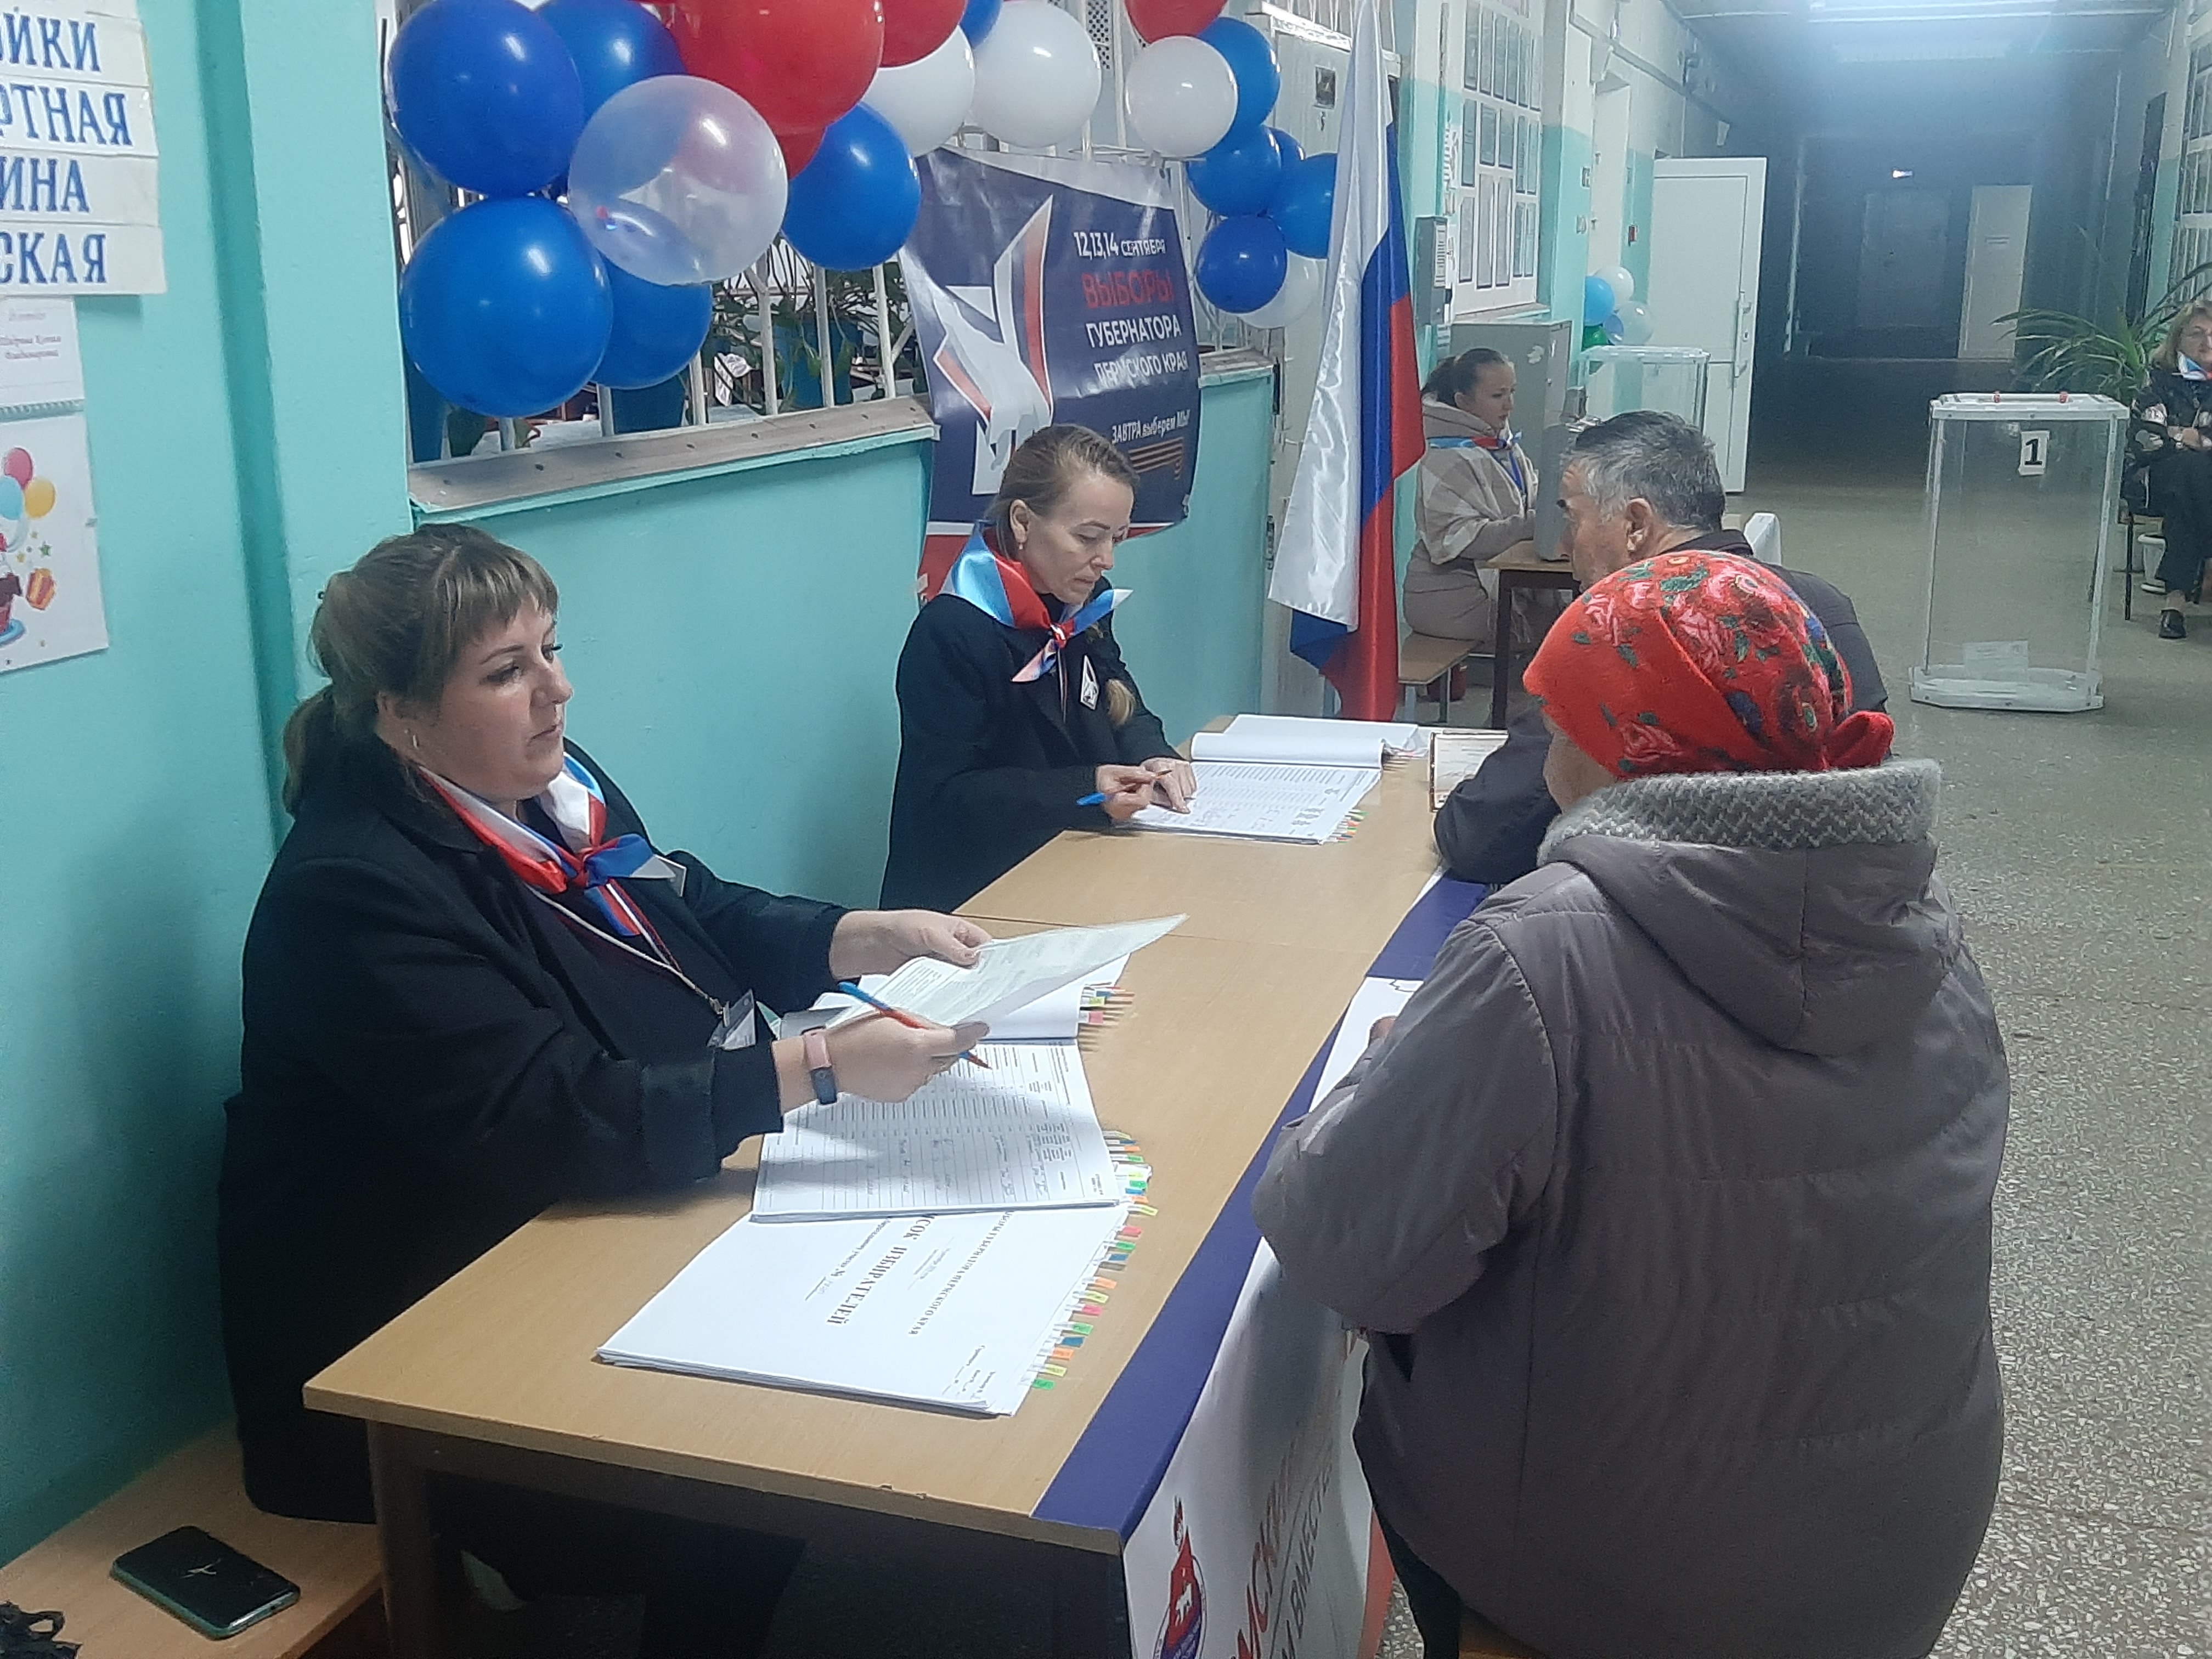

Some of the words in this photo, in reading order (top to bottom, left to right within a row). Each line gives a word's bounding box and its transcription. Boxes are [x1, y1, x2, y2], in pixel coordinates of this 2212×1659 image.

[0, 7, 101, 72] ЙКИ
[1074, 232, 1119, 260] 12,13,14
[1081, 269, 1175, 308] ВЫБОРЫ
[1086, 314, 1182, 348] ГУБЕРНАТОРА
[1094, 355, 1162, 387] ПЕРМСКОГО
[1162, 351, 1189, 373] КРАЯ
[1111, 420, 1141, 444] ЗАВТРА
[1141, 416, 1176, 438] выберем
[2024, 438, 2043, 466] 1
[826, 1246, 907, 1324] ИЗБИРАТЕЛЕЙ
[908, 1317, 929, 1335] КРАЯ
